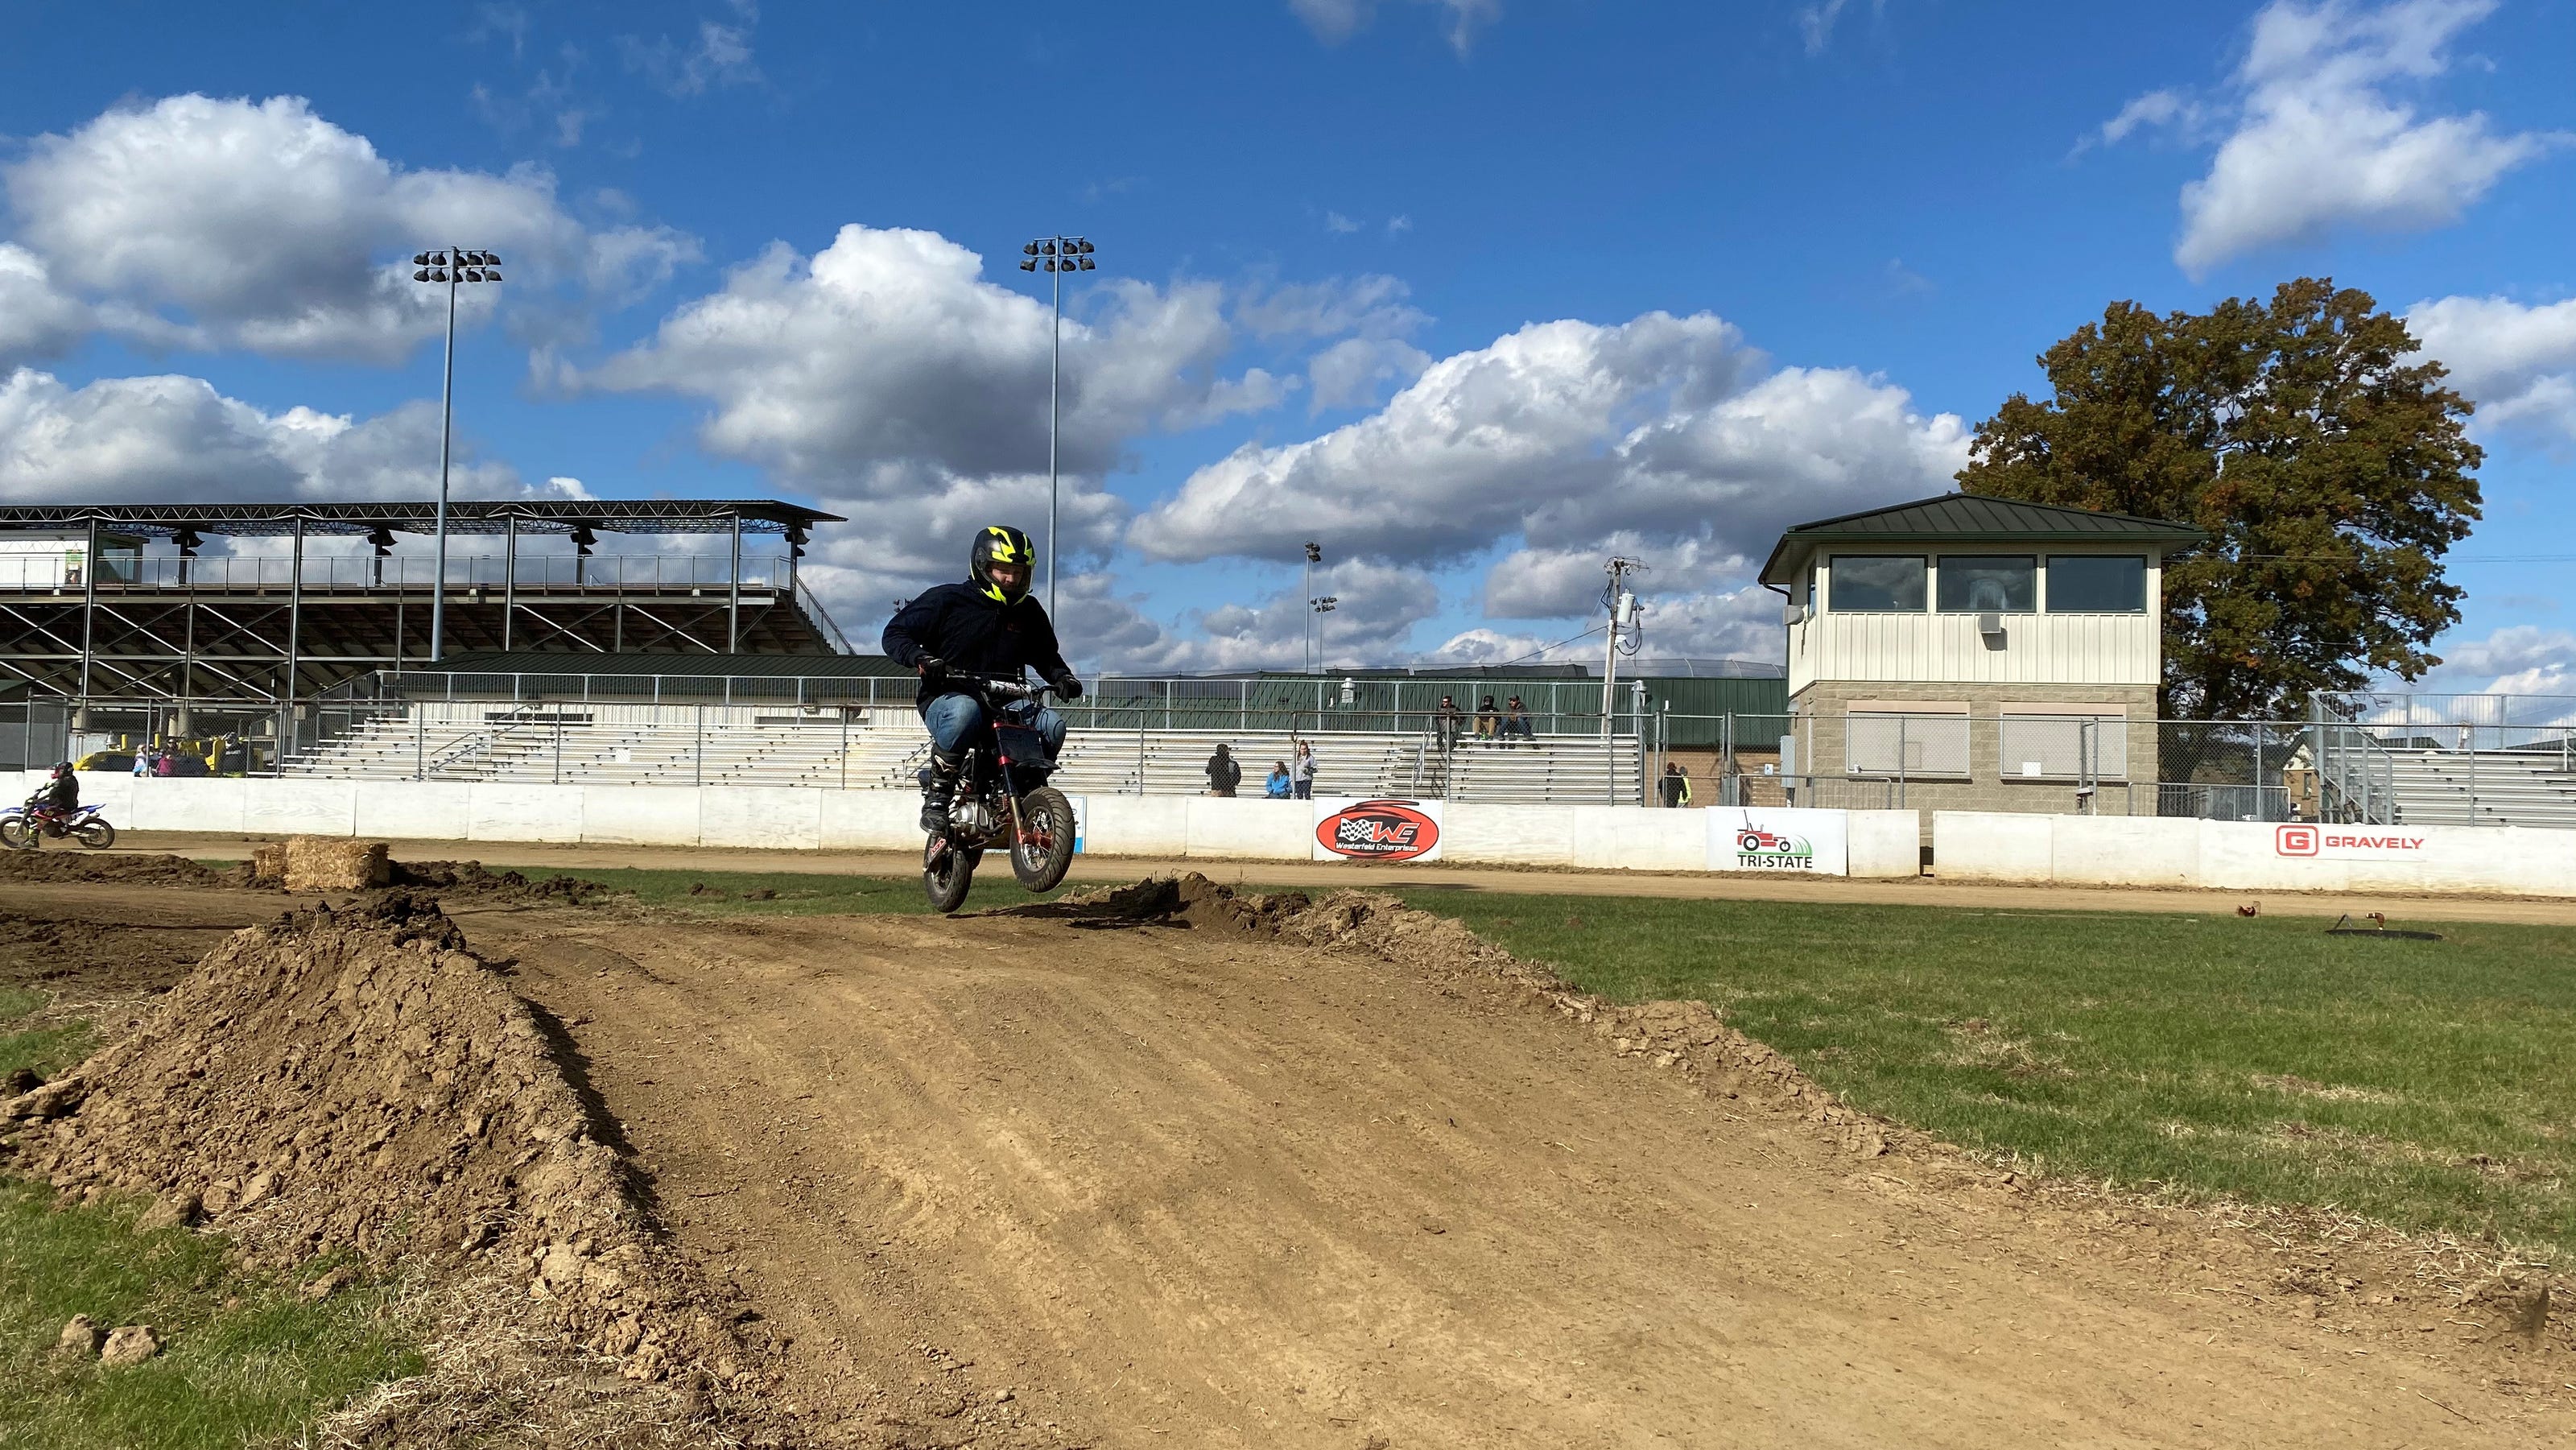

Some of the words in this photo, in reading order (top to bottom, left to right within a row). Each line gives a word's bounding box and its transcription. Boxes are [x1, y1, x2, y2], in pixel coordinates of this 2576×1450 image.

[1376, 843, 1418, 852] Enterprises
[2326, 836, 2425, 849] GRAVELY
[1737, 855, 1813, 869] TRI-STATE
